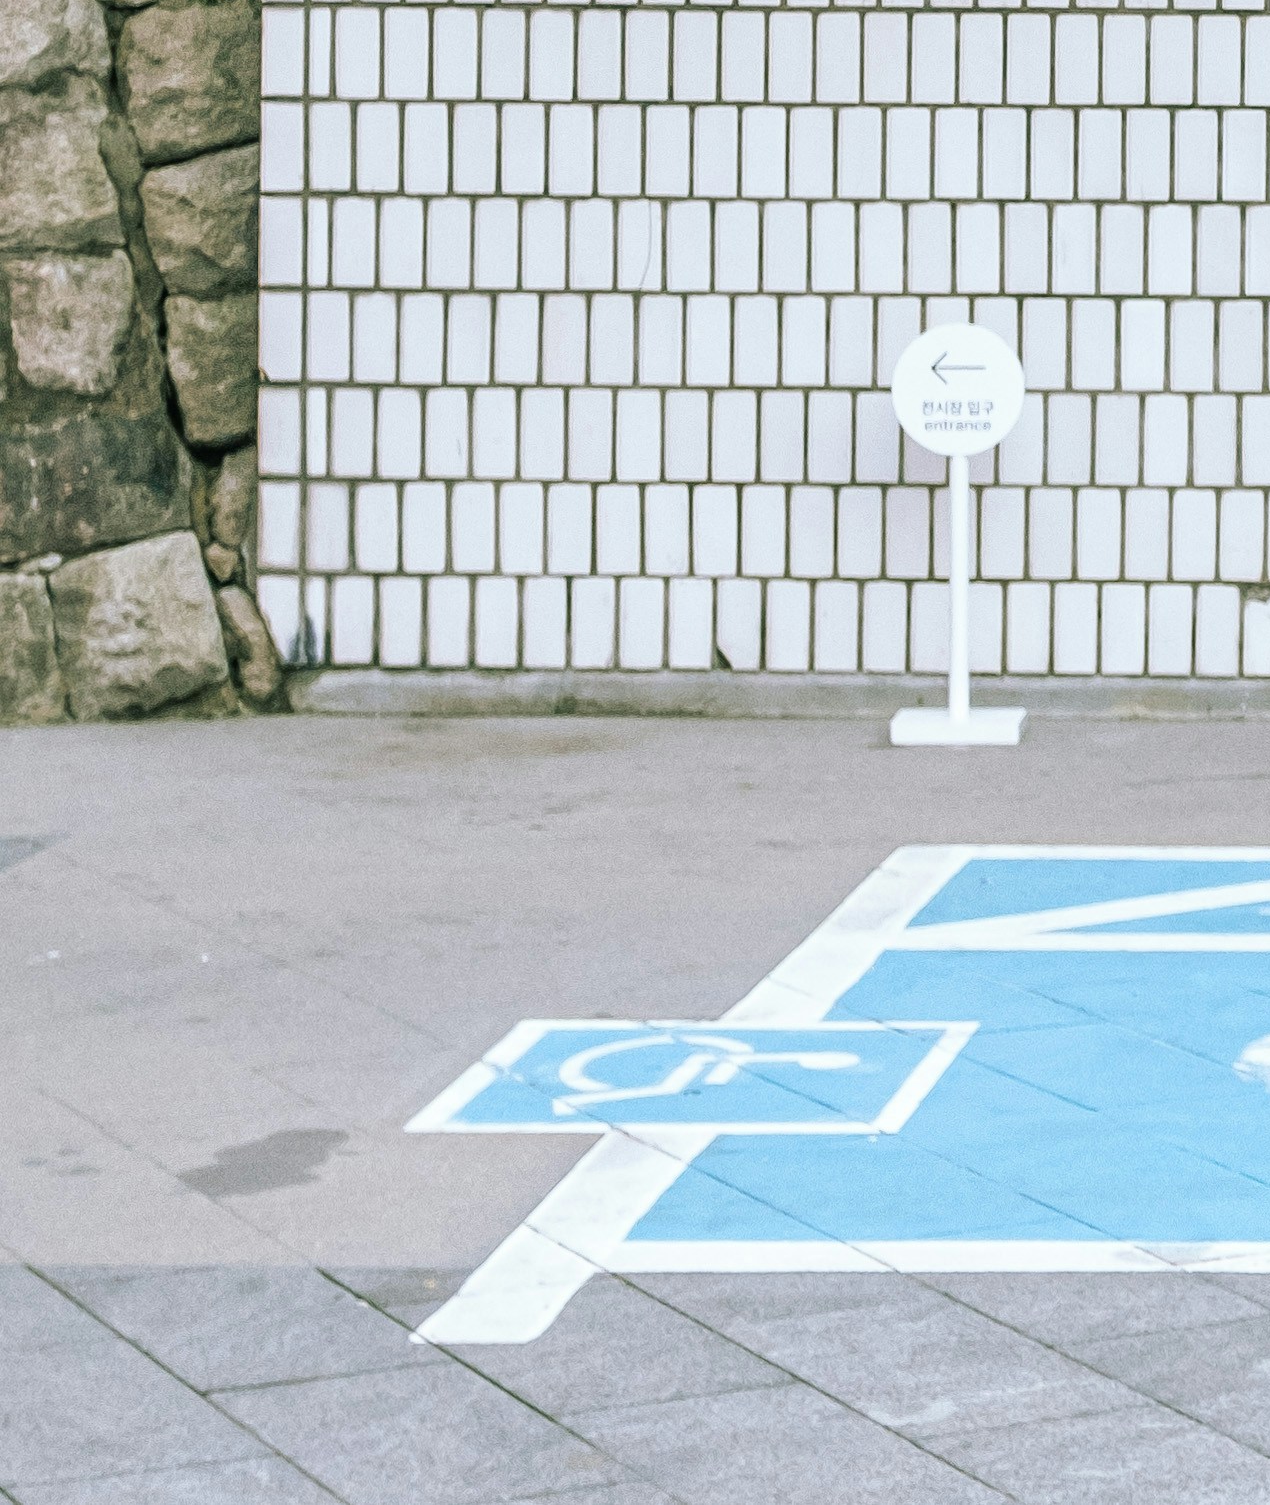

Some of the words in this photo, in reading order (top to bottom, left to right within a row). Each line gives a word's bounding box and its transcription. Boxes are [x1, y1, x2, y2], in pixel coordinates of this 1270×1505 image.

[922, 401, 962, 416] 전시장
[967, 401, 994, 415] 입구
[924, 420, 992, 432] entrance
